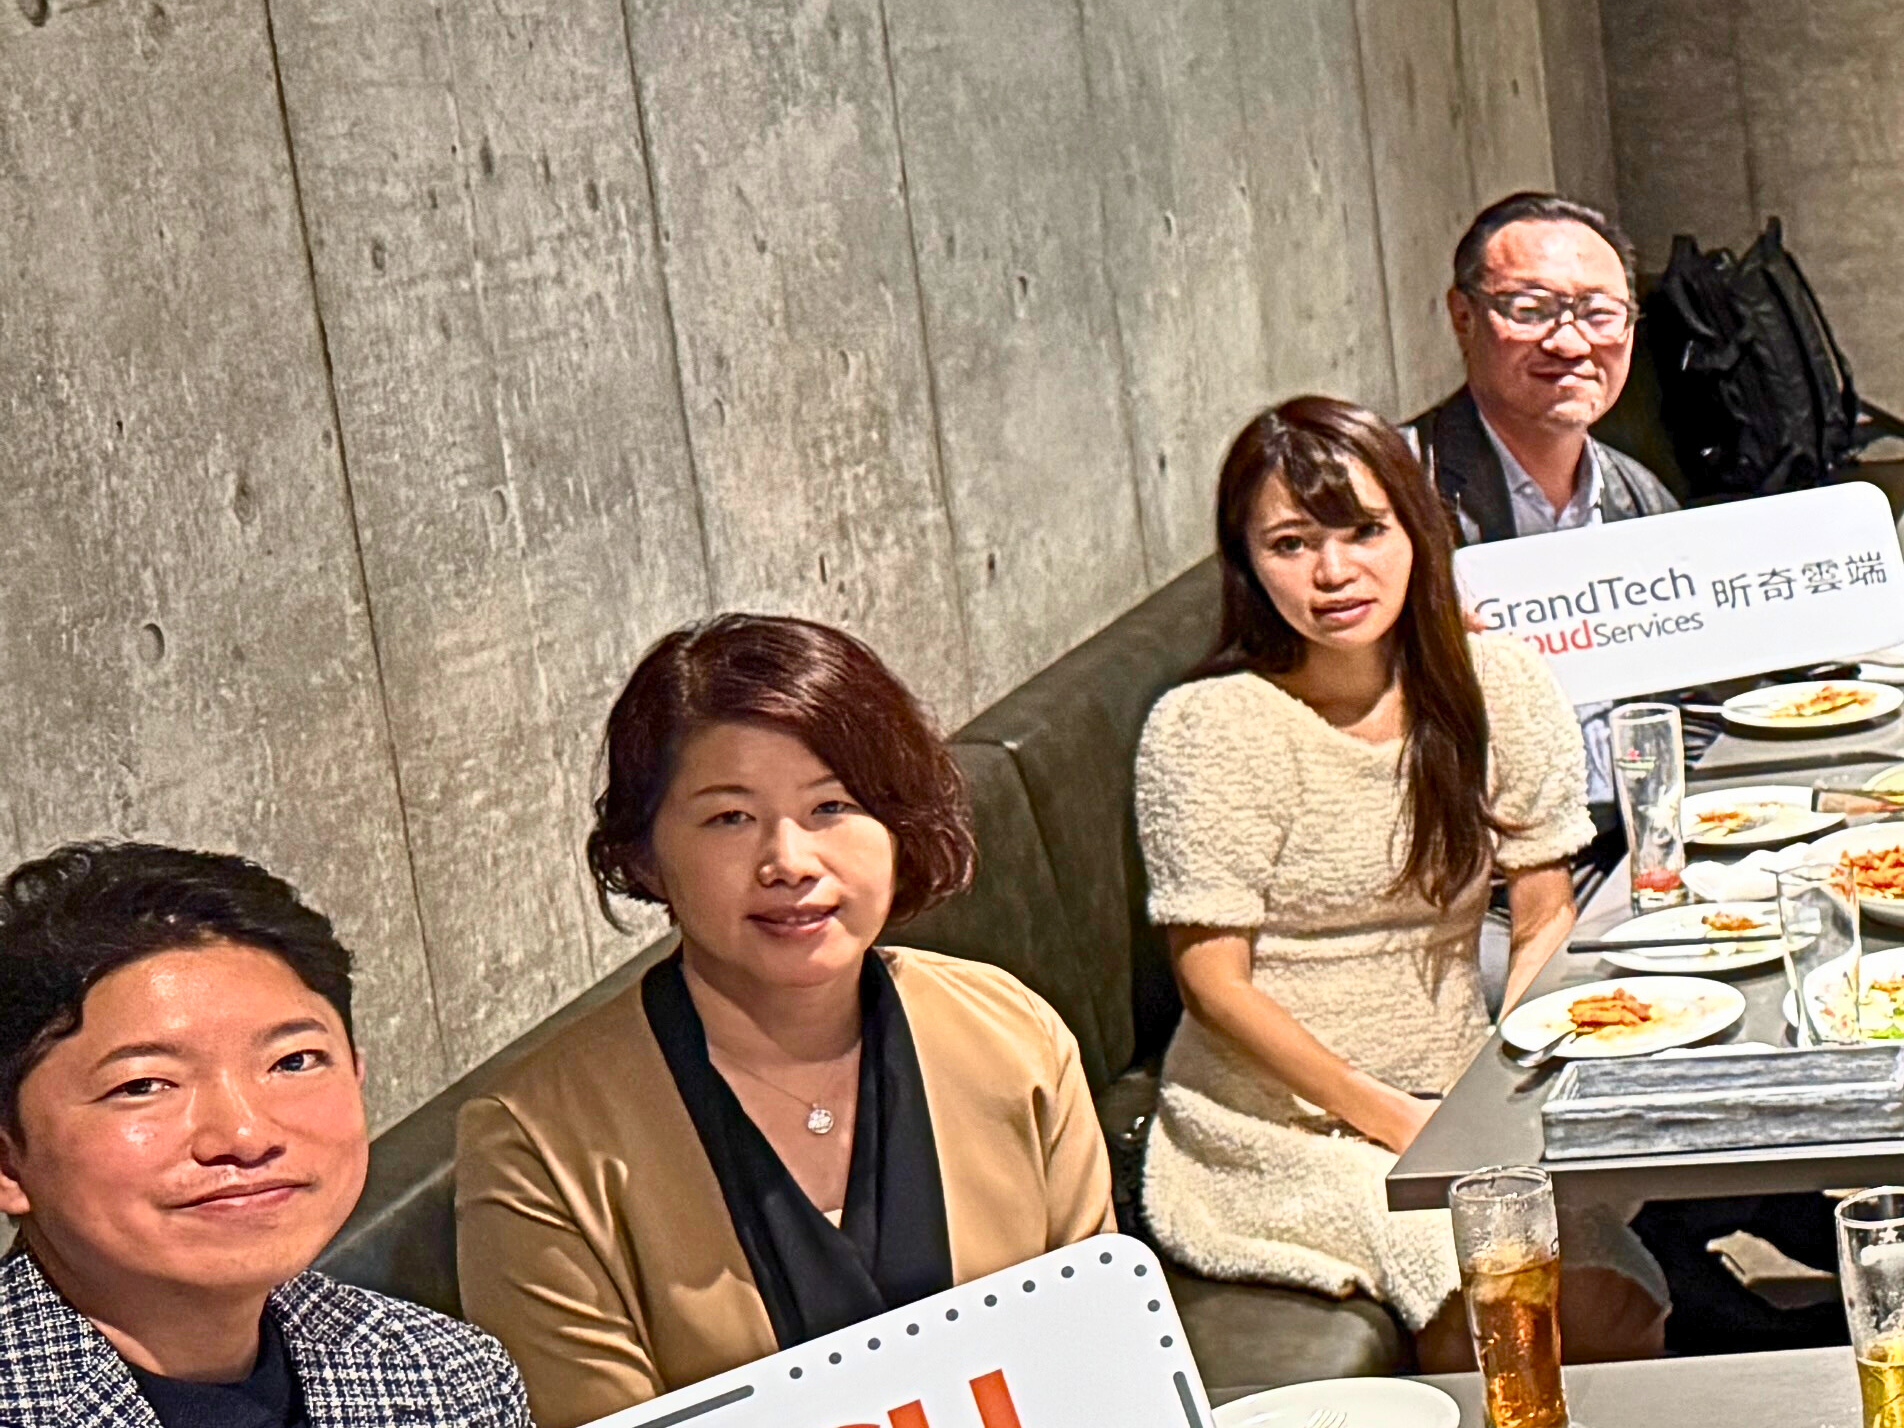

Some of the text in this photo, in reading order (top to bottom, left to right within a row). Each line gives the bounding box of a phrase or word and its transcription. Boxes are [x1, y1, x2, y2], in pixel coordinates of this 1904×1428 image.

[1474, 550, 1890, 632] GrandTech 昕奇雲端
